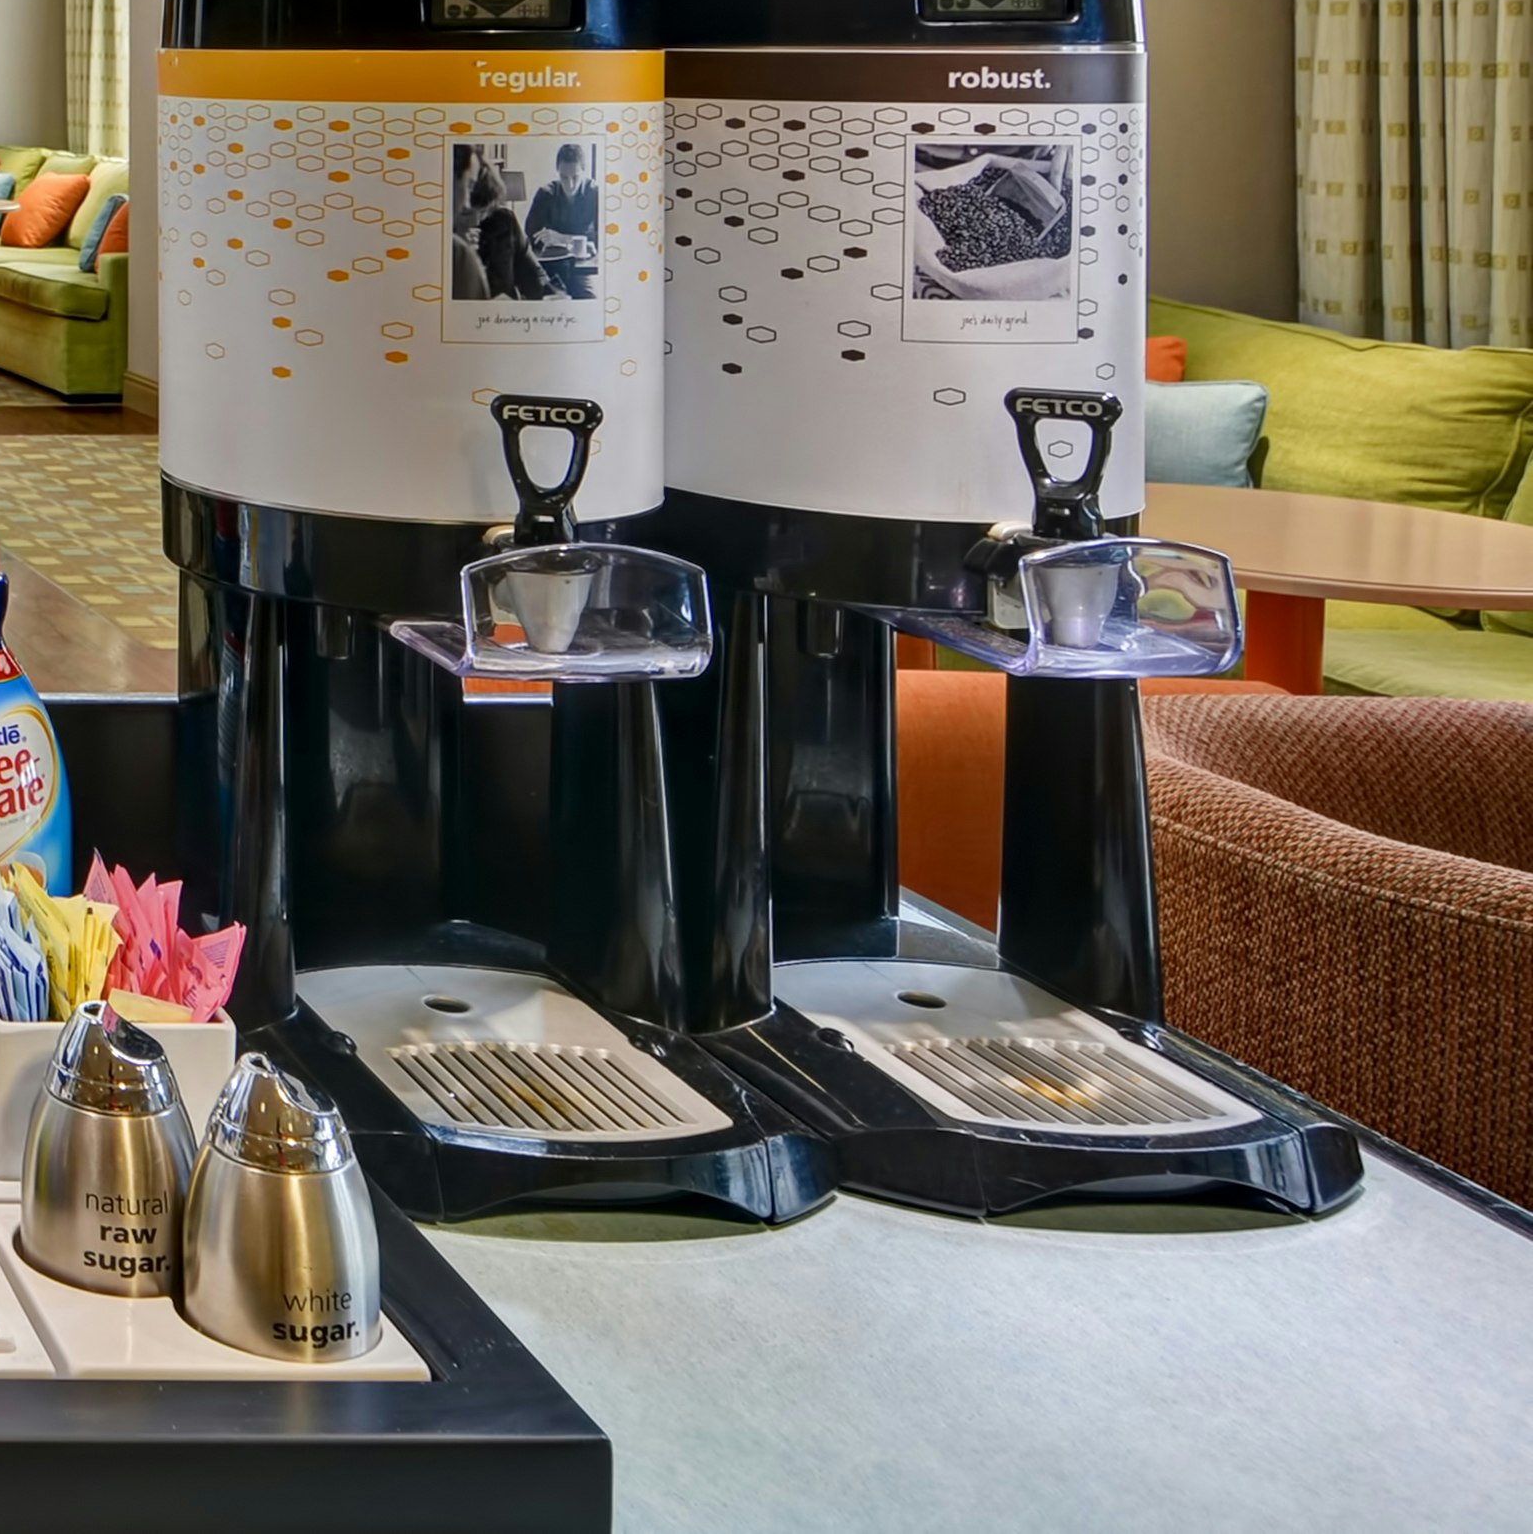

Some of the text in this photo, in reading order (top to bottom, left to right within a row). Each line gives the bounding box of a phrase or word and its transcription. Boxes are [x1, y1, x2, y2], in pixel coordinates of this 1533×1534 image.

[479, 65, 581, 93] regular.
[948, 66, 1051, 88] robust.
[502, 404, 585, 424] FETCO
[1016, 398, 1103, 417] FETCO
[85, 1190, 169, 1216] natural
[100, 1224, 157, 1244] raw
[83, 1249, 171, 1278] sugar.
[283, 1289, 352, 1313] white
[273, 1320, 360, 1349] sugar.
